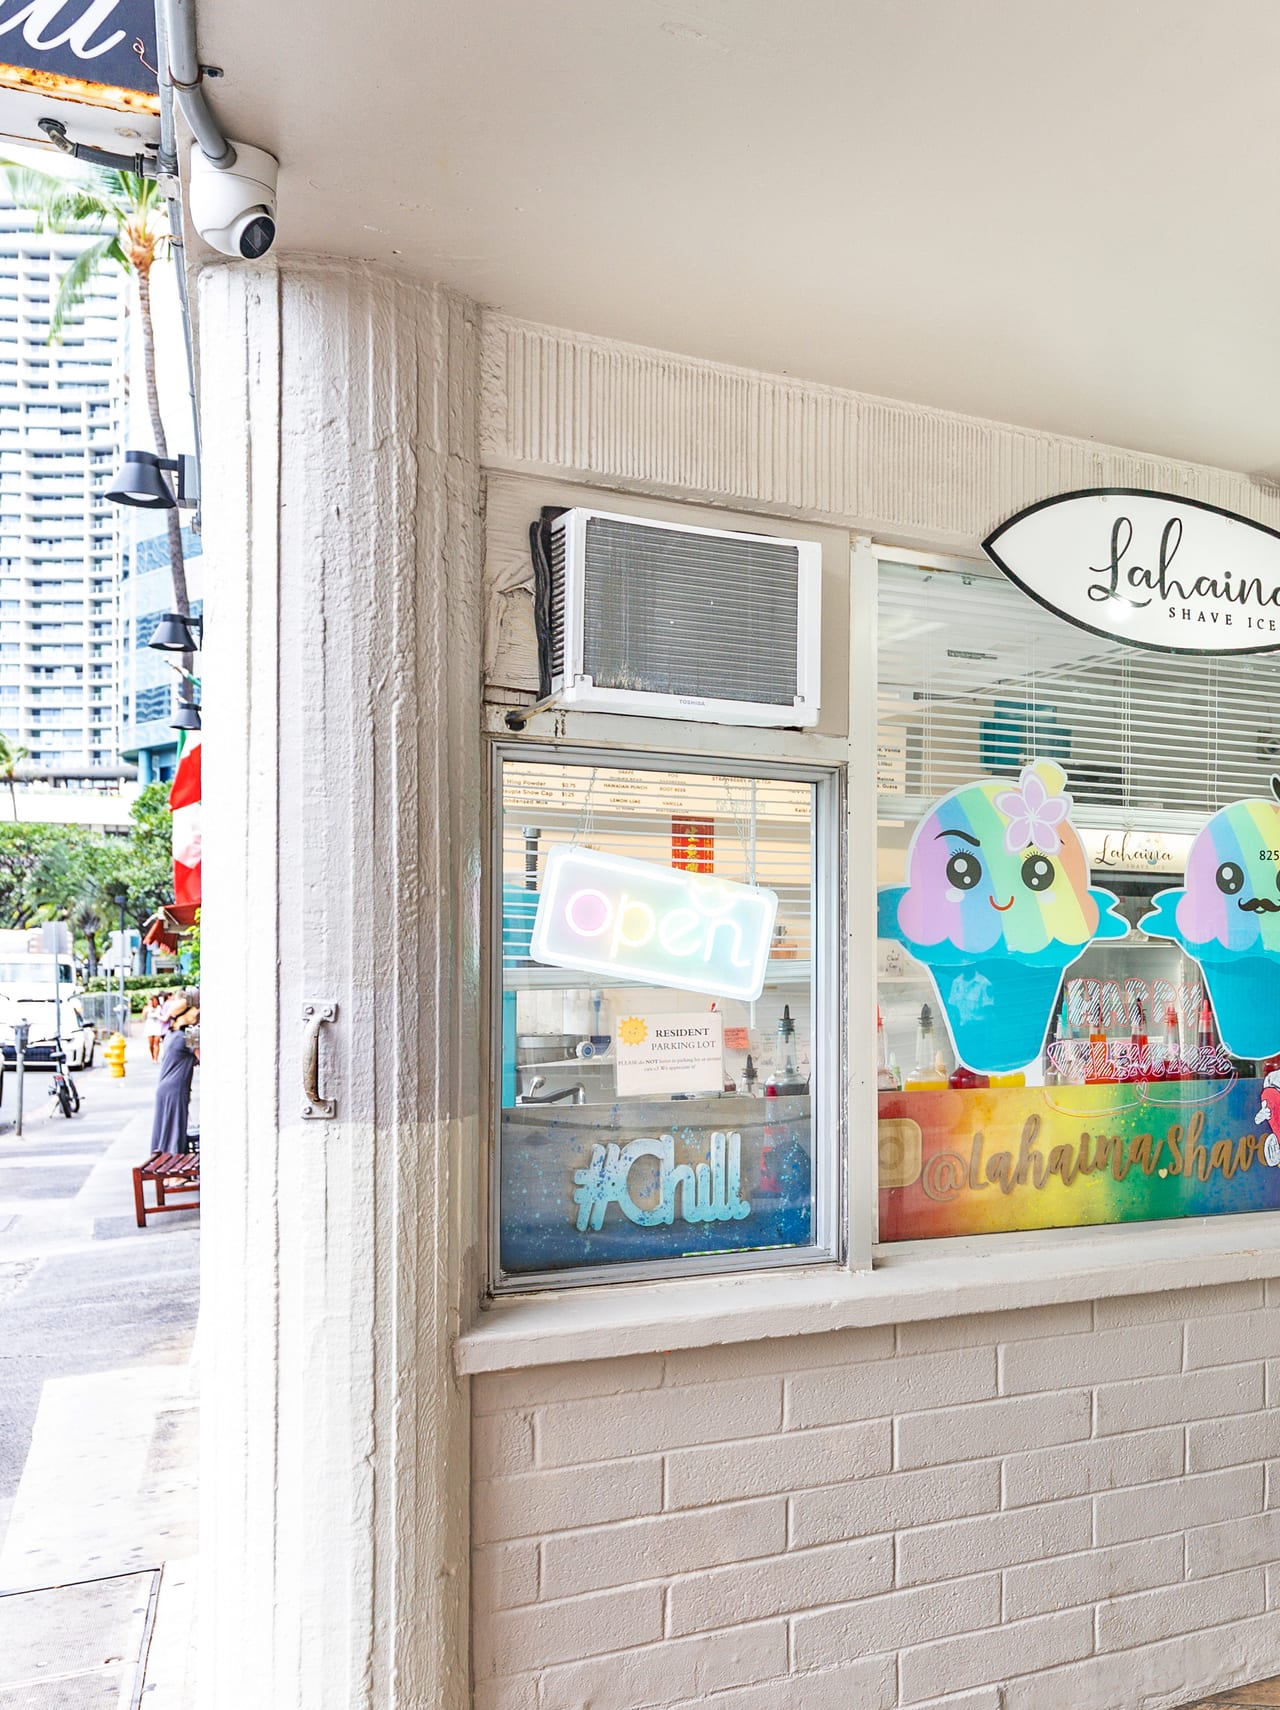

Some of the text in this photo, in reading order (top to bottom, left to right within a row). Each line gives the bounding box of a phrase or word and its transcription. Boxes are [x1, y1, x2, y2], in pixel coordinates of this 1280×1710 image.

[1169, 607, 1276, 631] SHAVE ICE
[1094, 831, 1174, 866] Lahaina
[565, 888, 751, 968] open
[1067, 978, 1204, 1029] HAPPY
[651, 1040, 716, 1051] PARKING LOT
[655, 1028, 709, 1037] RESIDENT
[574, 1131, 751, 1232] #Chill
